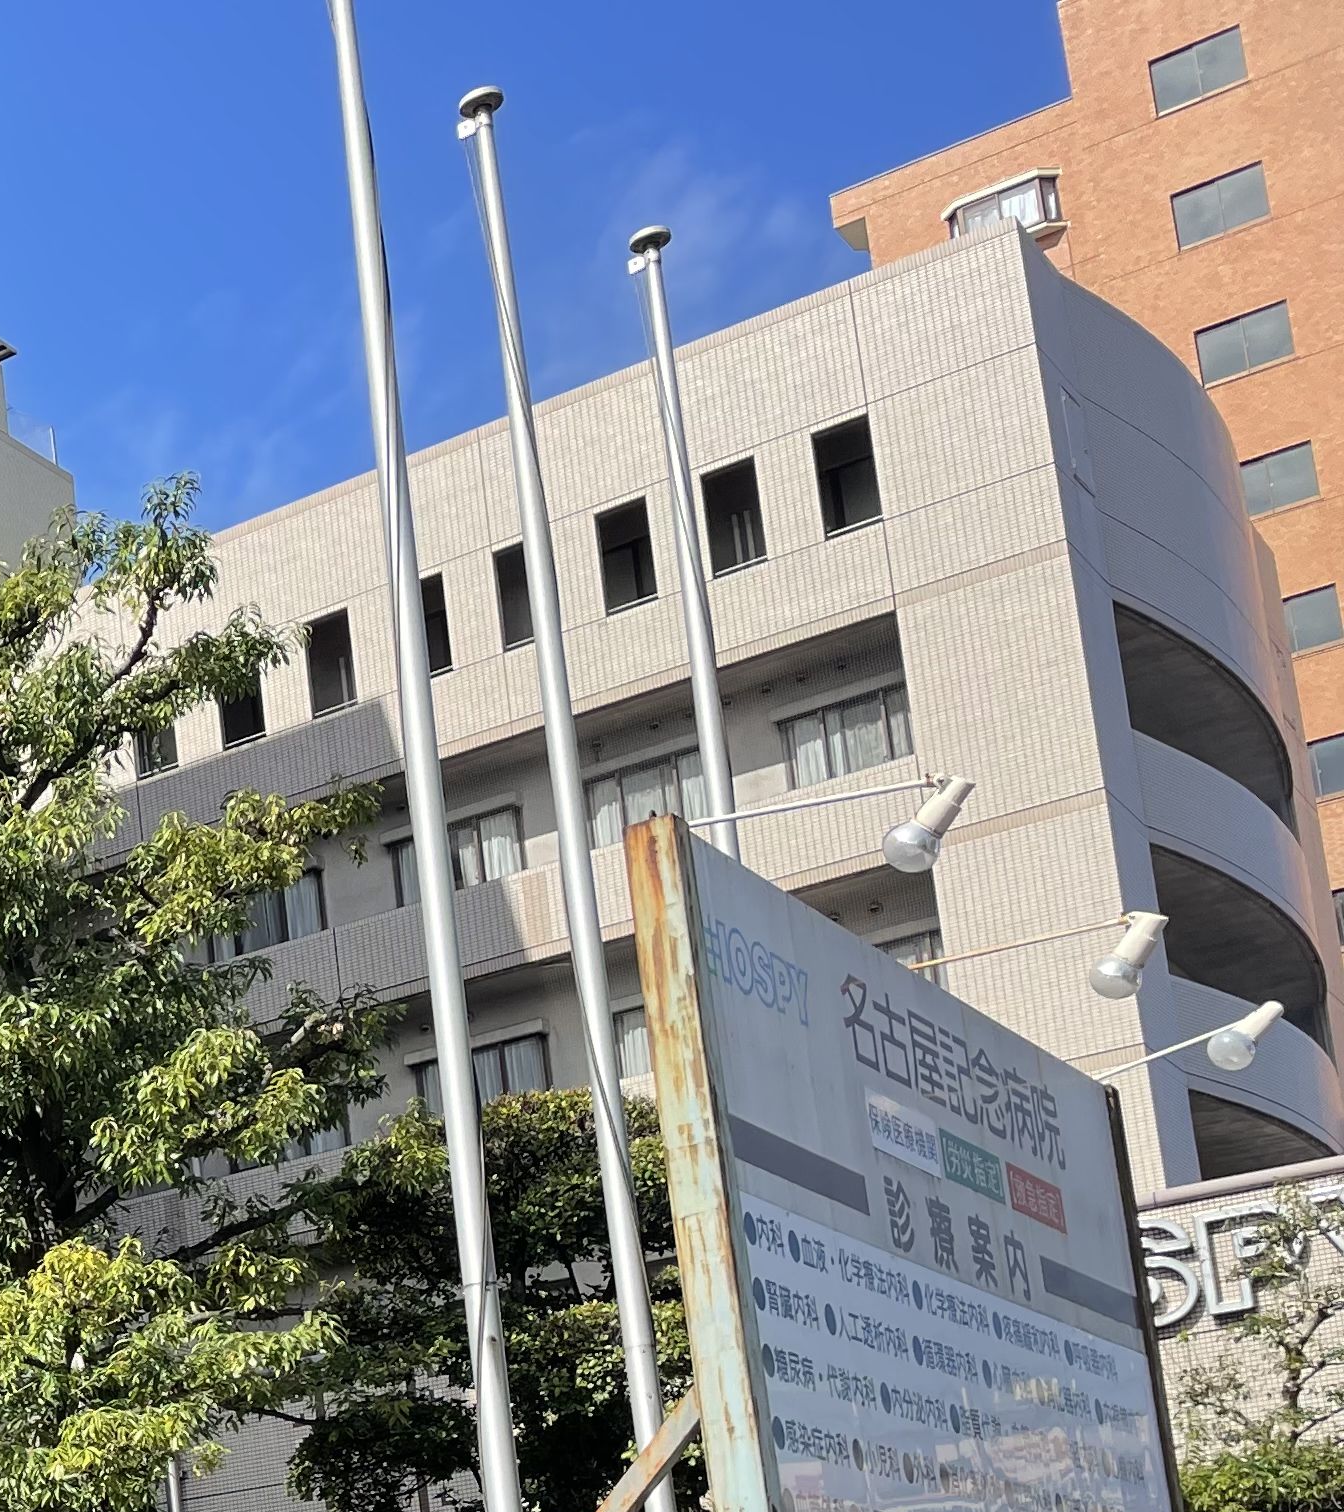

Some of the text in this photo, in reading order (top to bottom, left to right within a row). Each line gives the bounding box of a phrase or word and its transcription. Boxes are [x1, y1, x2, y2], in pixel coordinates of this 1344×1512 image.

[840, 972, 1065, 1170] 名古屋記念病院
[867, 1101, 939, 1166] 保険医療機関
[754, 1213, 786, 1261] 内科
[799, 1230, 911, 1307] 血液・化学療法内科
[921, 1278, 990, 1336] 化学療法内科
[885, 1175, 1030, 1303] 診療案内
[763, 1278, 820, 1332] 腎臓内科
[834, 1303, 910, 1362] 人工透析内科
[921, 1333, 979, 1384] 循環器内科
[782, 1418, 851, 1469] 感染症内科
[862, 1439, 901, 1481] 小児科
[910, 1452, 938, 1490] 外科
[889, 1382, 949, 1432] 内分泌内科
